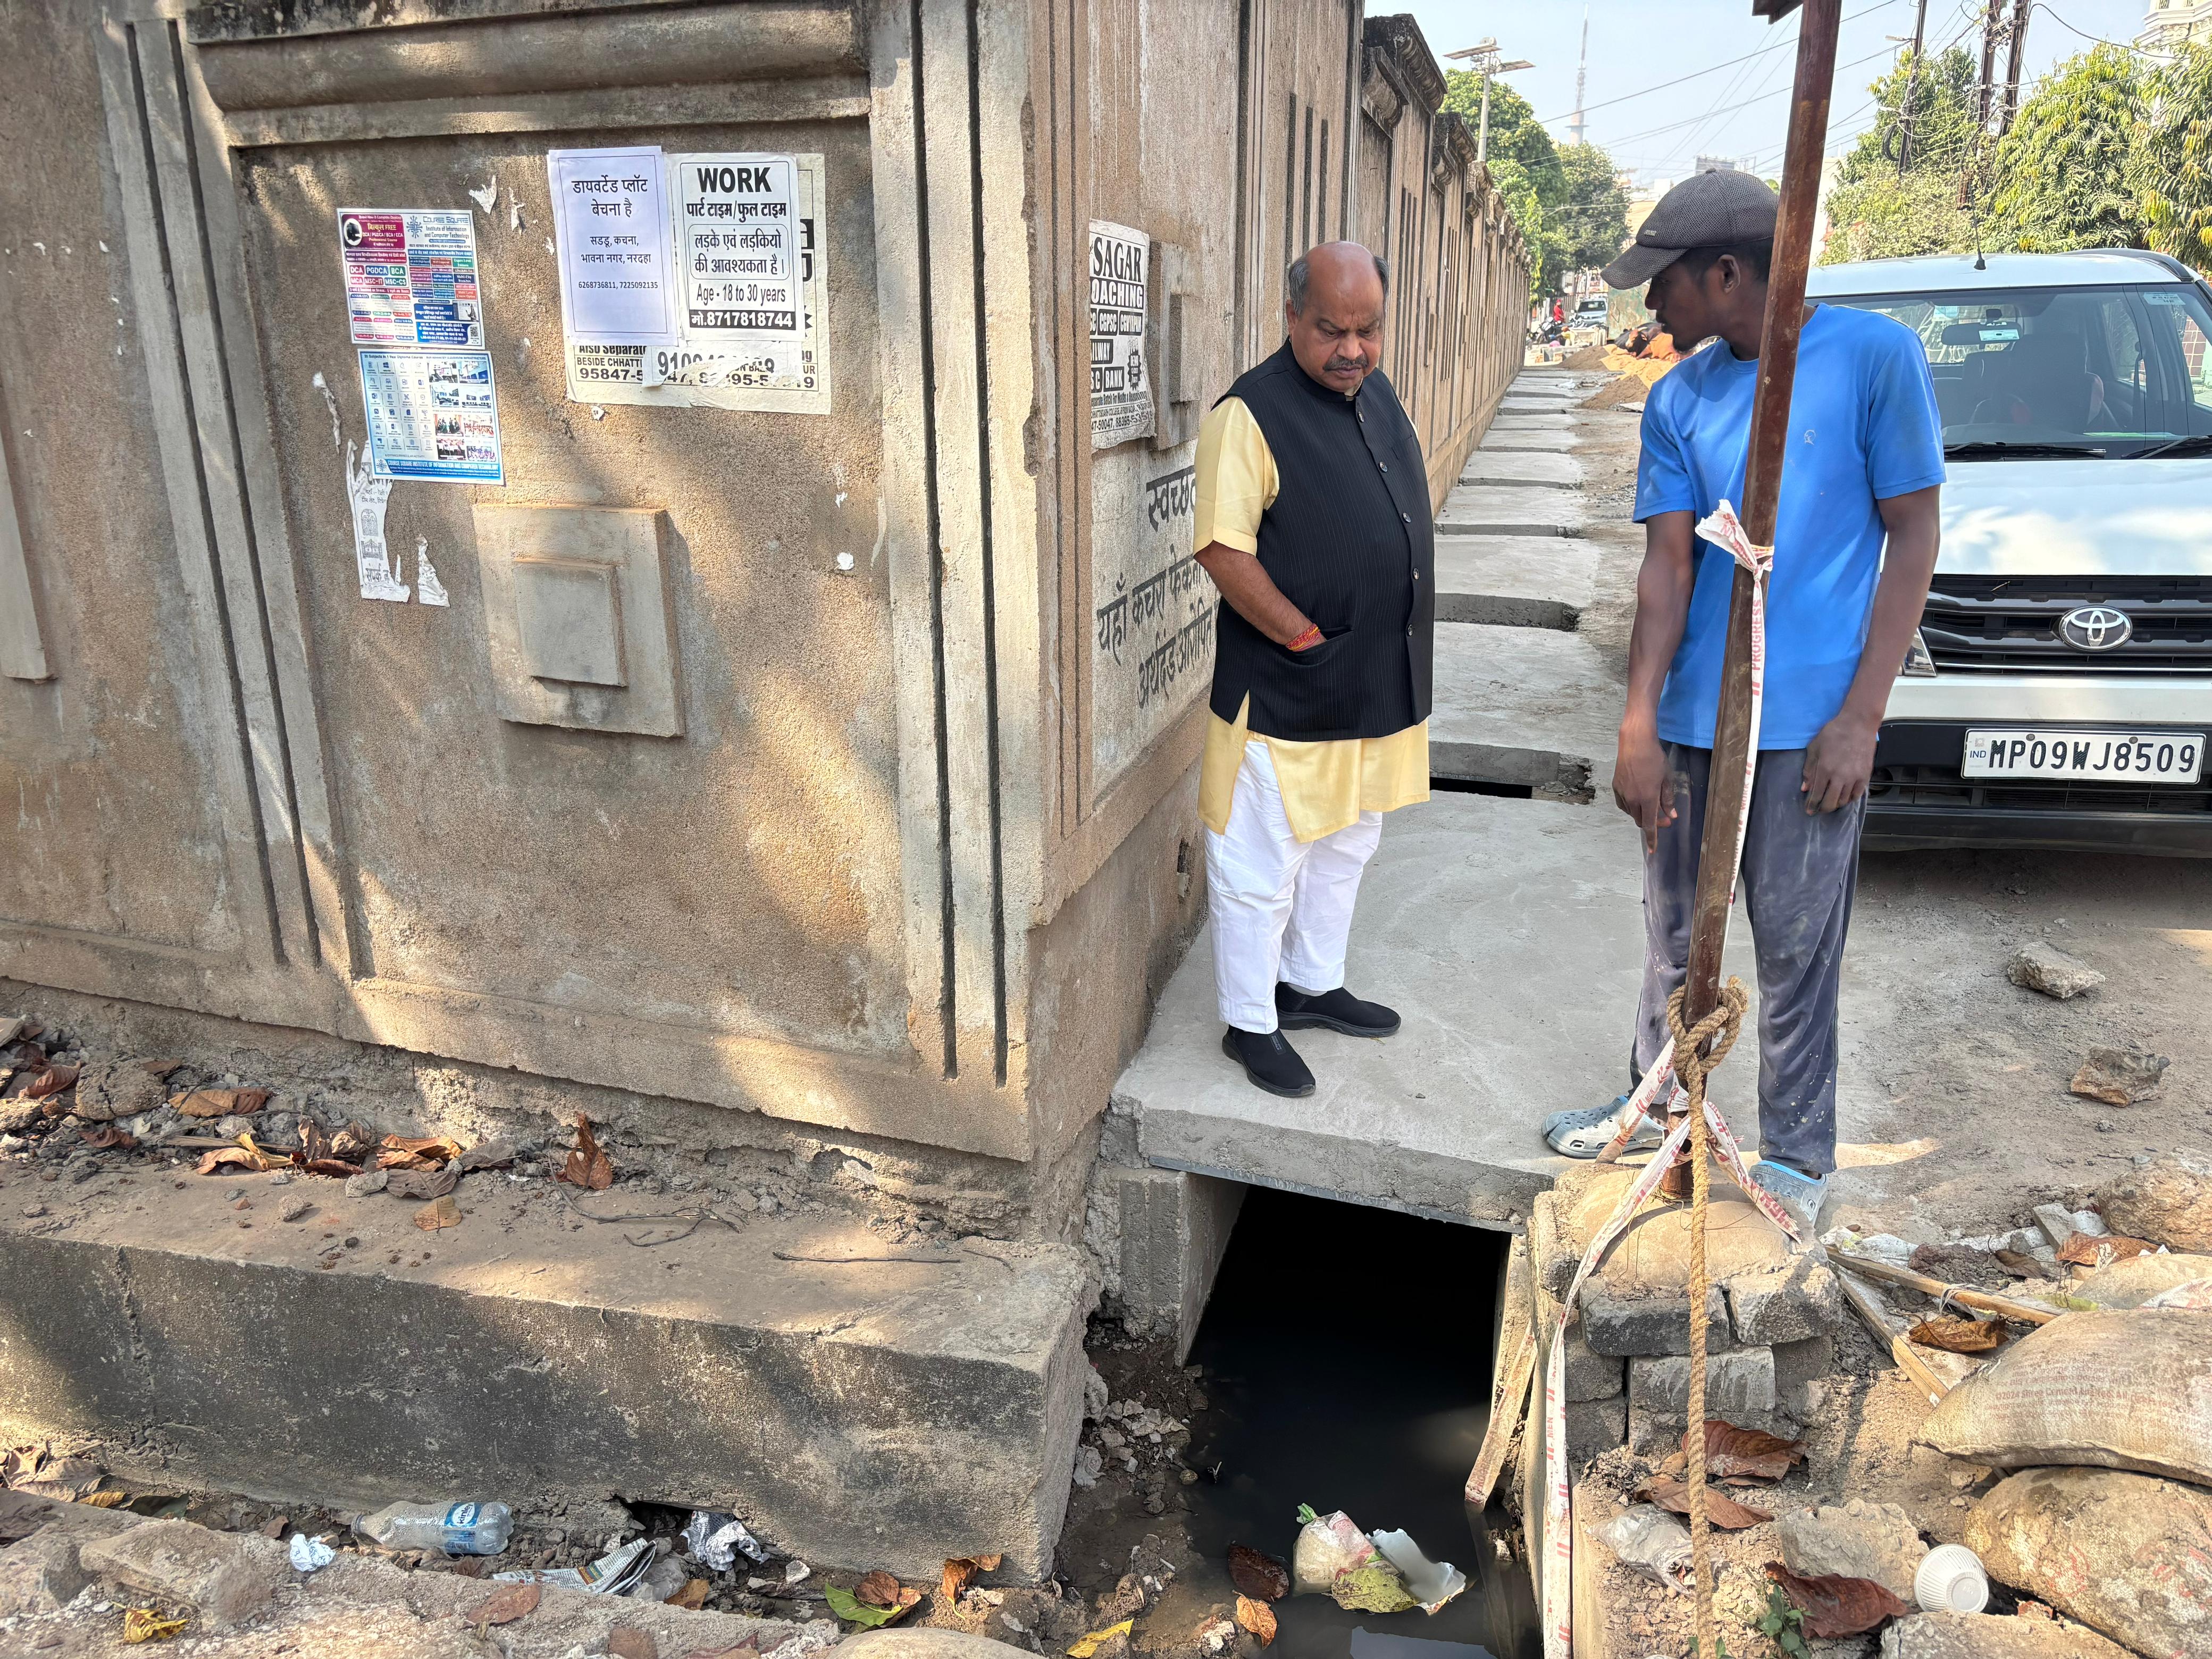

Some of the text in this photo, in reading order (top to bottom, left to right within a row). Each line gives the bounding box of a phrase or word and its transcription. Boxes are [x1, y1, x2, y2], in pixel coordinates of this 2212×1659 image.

[571, 174, 648, 193] डायवर्टेड प्लॉट
[697, 167, 772, 193] WORK
[591, 198, 632, 217] बेचना है
[686, 197, 705, 216] पार्ट
[760, 203, 786, 219] टाइम
[613, 236, 639, 246] कचना,
[694, 229, 720, 252] लड़के
[723, 228, 736, 250] एवं
[581, 254, 651, 264] भावना नगर, नरदहा
[694, 253, 708, 272] की
[711, 259, 767, 273] आवश्यकता
[1094, 237, 1141, 282] SAGAR
[697, 283, 714, 306] Age
[723, 283, 733, 301] 18
[735, 285, 744, 301] to
[747, 284, 758, 301] 30
[760, 288, 785, 306] years
[1091, 279, 1143, 308] OACHING
[1100, 313, 1117, 332] CGPSC
[1091, 342, 1110, 361] ILWAY
[577, 357, 605, 366] BESIDE
[1105, 369, 1123, 388] BANK
[1091, 418, 1115, 431] 47-50047,
[1752, 599, 1762, 671] PROGRESS
[1989, 740, 2195, 773] MP09WJ8509
[1645, 1088, 1655, 1103] MEN
[457, 1504, 473, 1524] kinley
